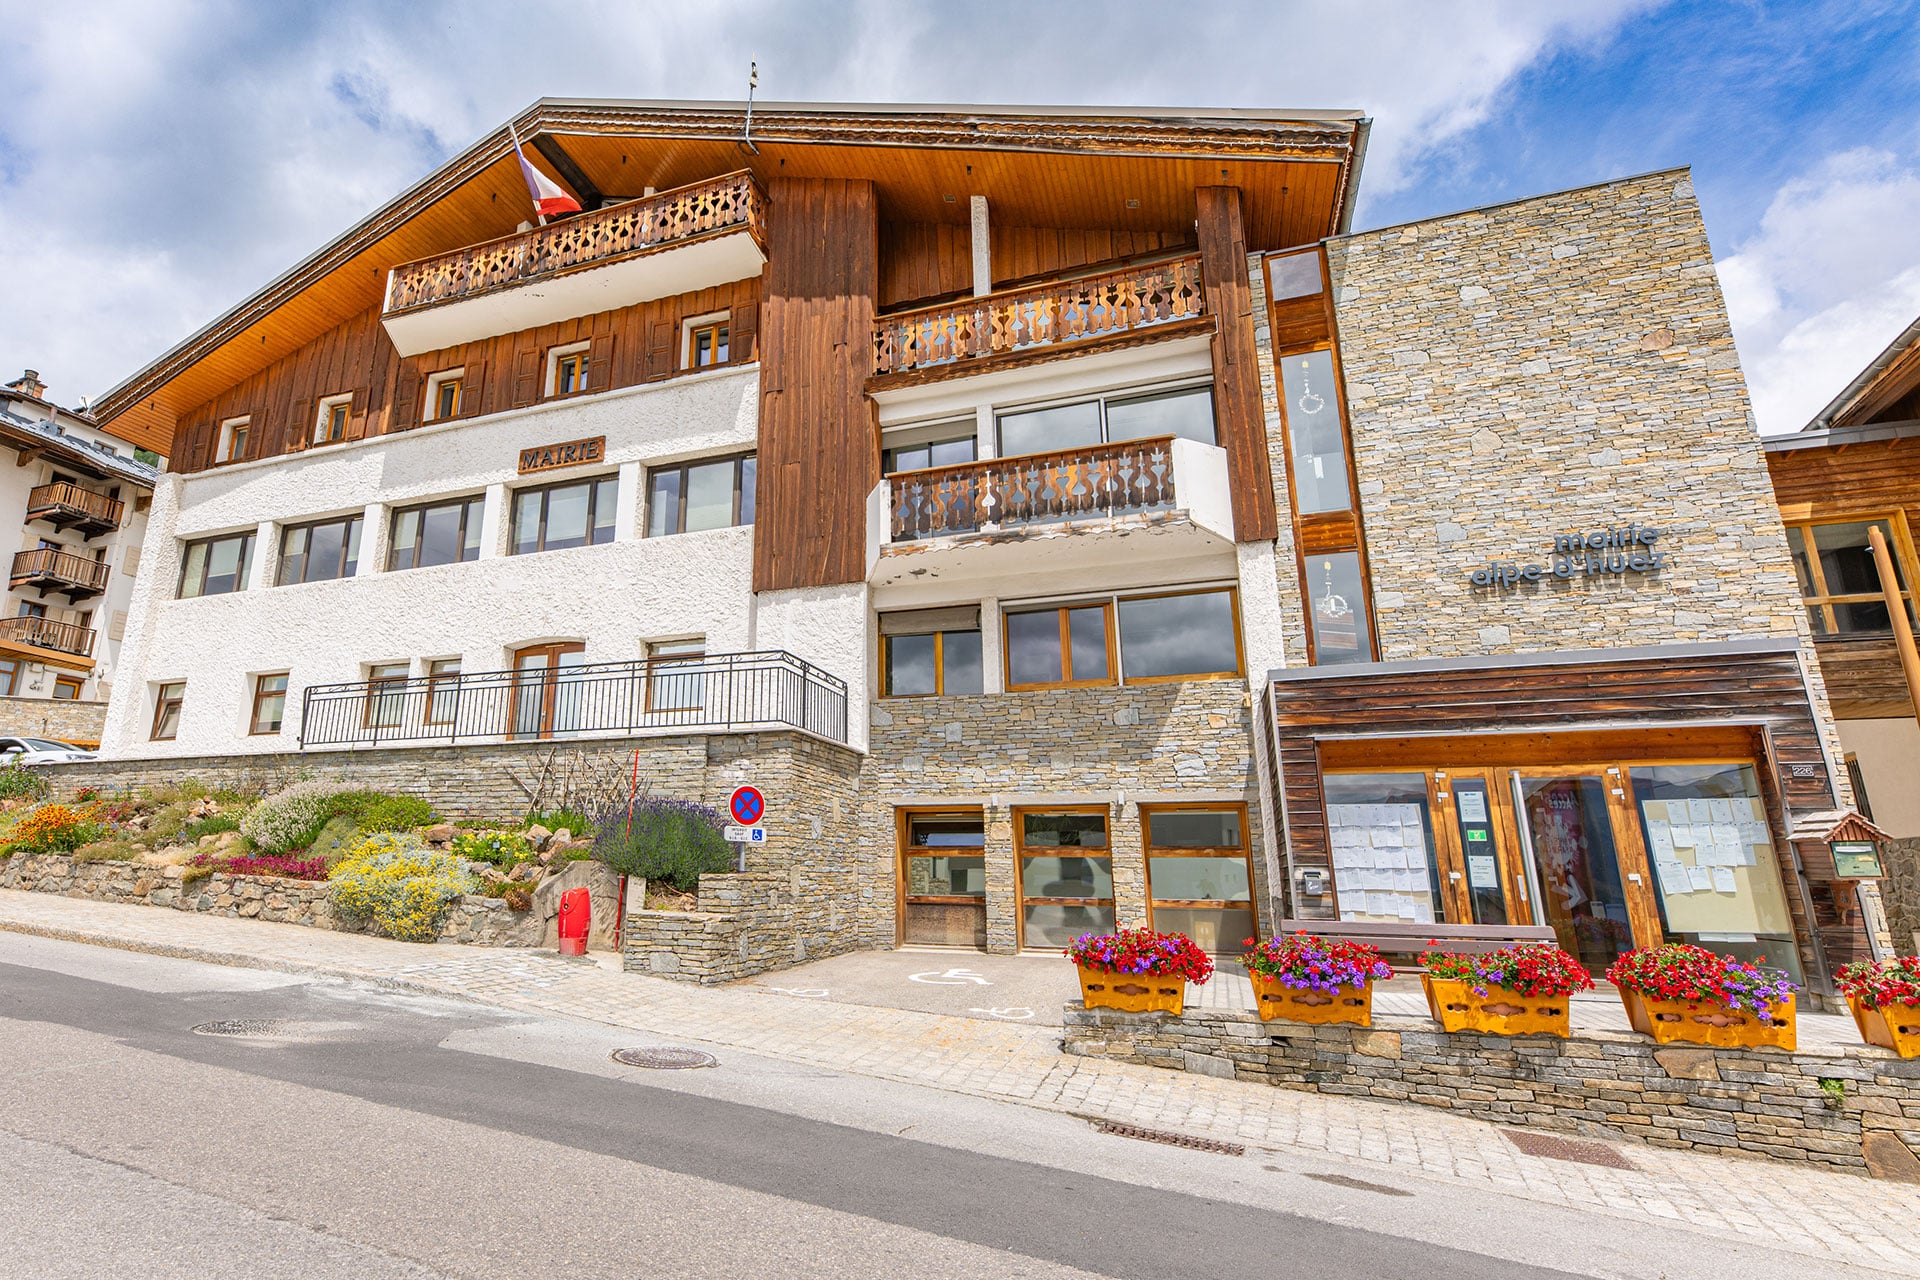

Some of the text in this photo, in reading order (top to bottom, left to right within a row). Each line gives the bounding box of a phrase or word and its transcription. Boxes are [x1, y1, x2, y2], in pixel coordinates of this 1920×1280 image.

[522, 440, 599, 470] MAIRIE
[1554, 523, 1660, 552] mairie
[1471, 552, 1668, 588] alpe d'huez
[1794, 767, 1812, 775] 226
